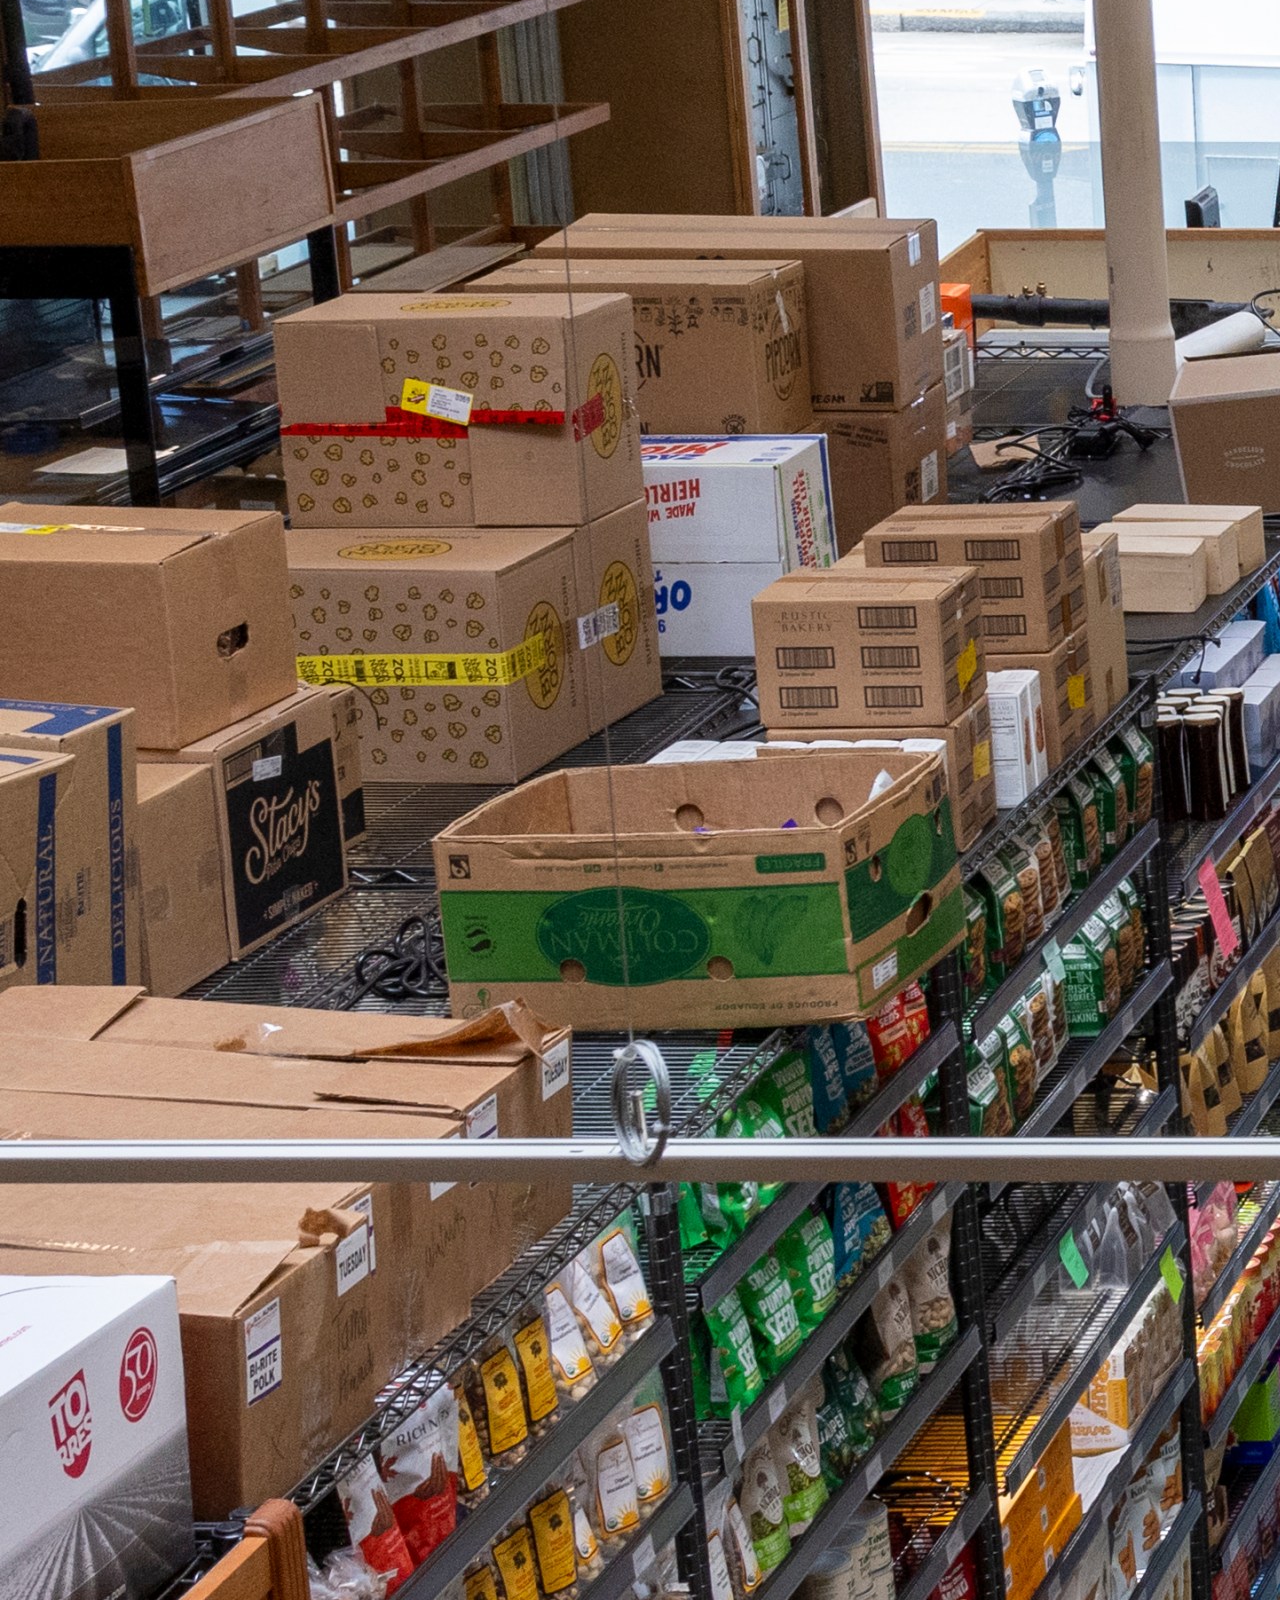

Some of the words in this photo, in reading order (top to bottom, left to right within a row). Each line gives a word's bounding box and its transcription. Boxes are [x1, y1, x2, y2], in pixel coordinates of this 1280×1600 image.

[765, 331, 802, 384] PIPCORN
[666, 502, 696, 519] MADE
[781, 611, 832, 622] RUSTIC
[781, 622, 833, 633] BAKERY
[245, 779, 321, 885] Stacy's
[107, 798, 126, 950] DELICIOUS
[761, 855, 824, 871] FRAGILE
[36, 824, 56, 967] NATURAL
[769, 1002, 783, 1011] OF
[787, 1000, 840, 1010] PRODUCE
[1068, 1012, 1099, 1024] BAKING
[543, 1060, 569, 1086] TUESDAY
[338, 1246, 368, 1276] TUESDAY
[248, 1351, 279, 1380] BI-RITE
[252, 1370, 277, 1396] POLK
[396, 1419, 427, 1448] RICH
